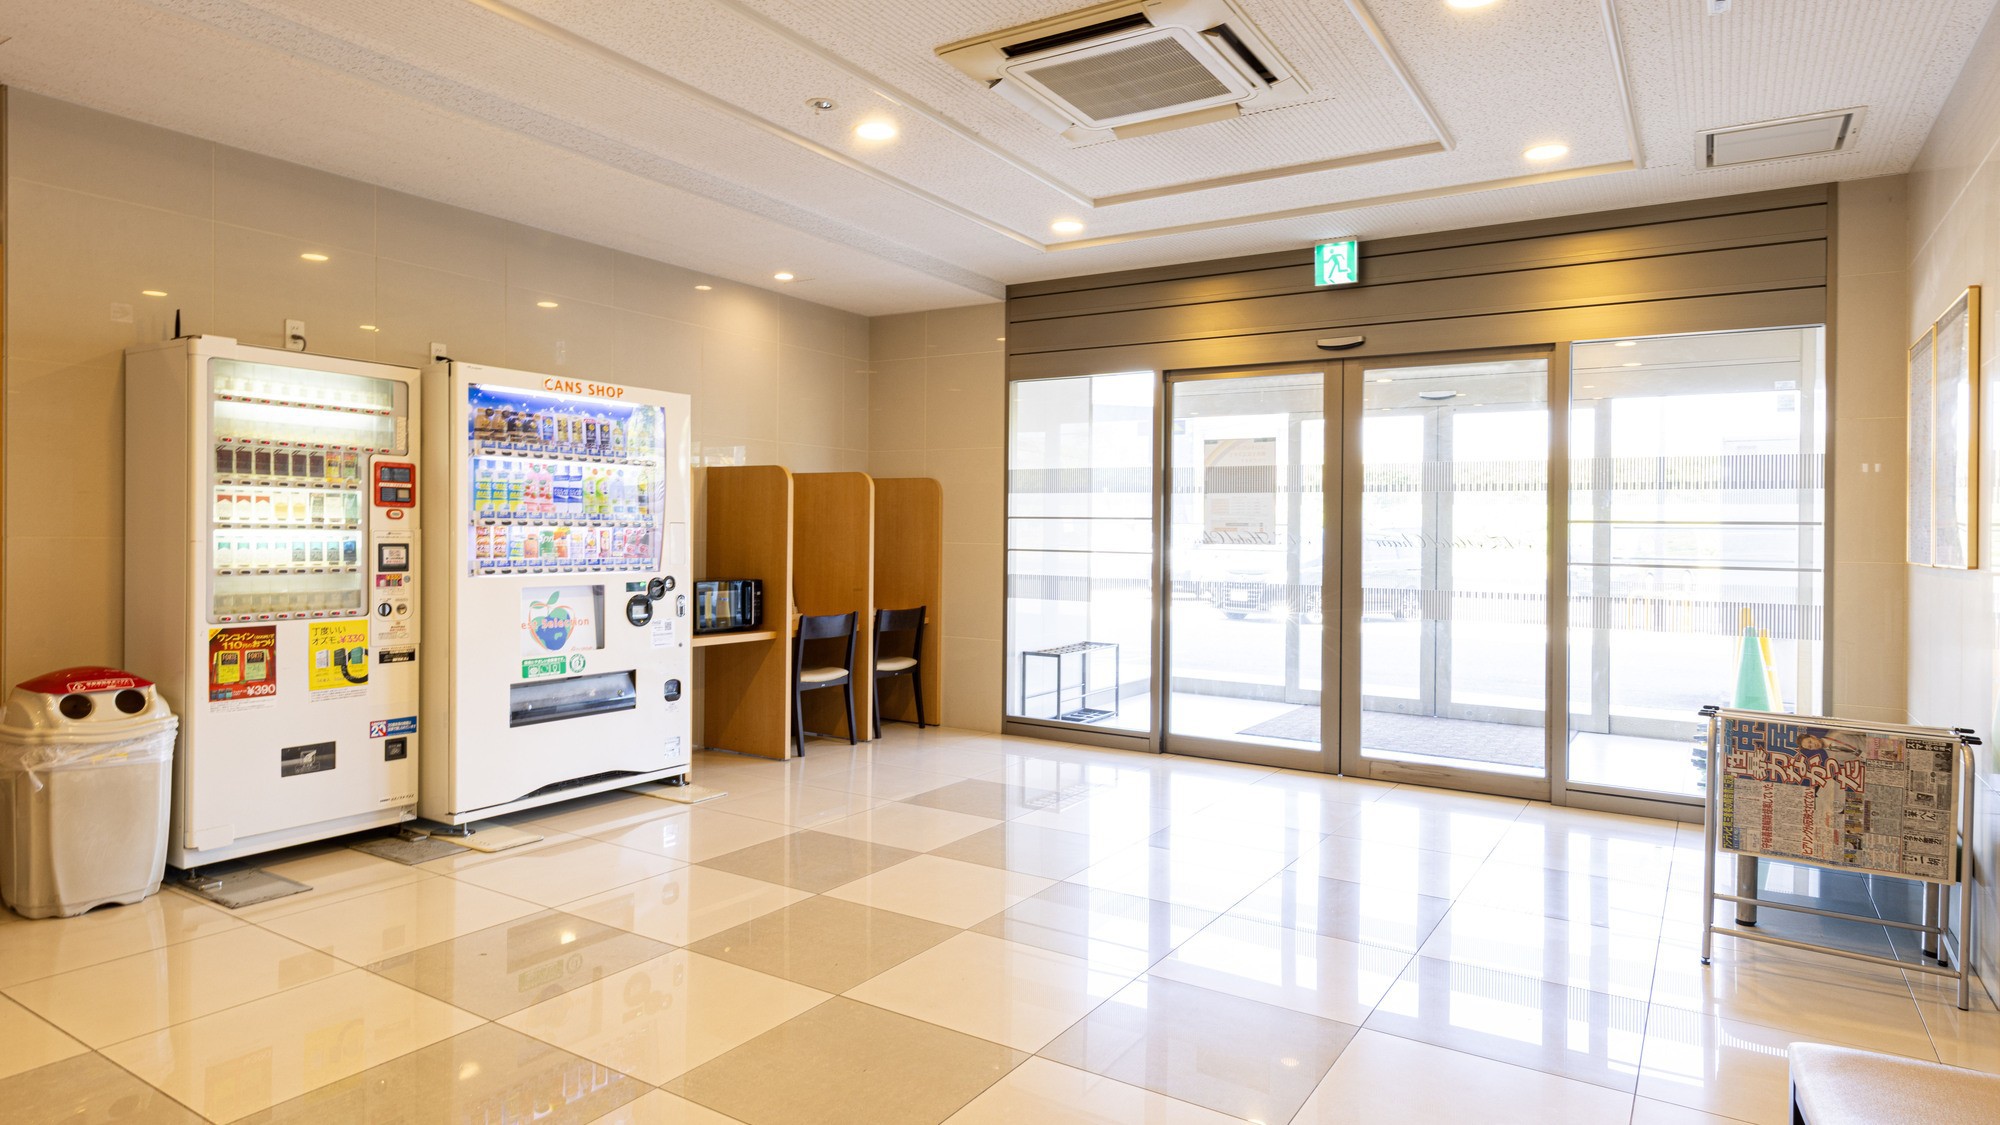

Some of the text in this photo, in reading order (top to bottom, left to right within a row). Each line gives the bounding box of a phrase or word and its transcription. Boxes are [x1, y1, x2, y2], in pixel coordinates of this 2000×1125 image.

[544, 377, 624, 398] CANS SHOP
[312, 626, 346, 636] 丁度いい
[217, 632, 254, 642] ワンコイン
[340, 634, 365, 644] ¥330
[247, 684, 276, 696] ¥390
[1732, 719, 1798, 757] 中居
